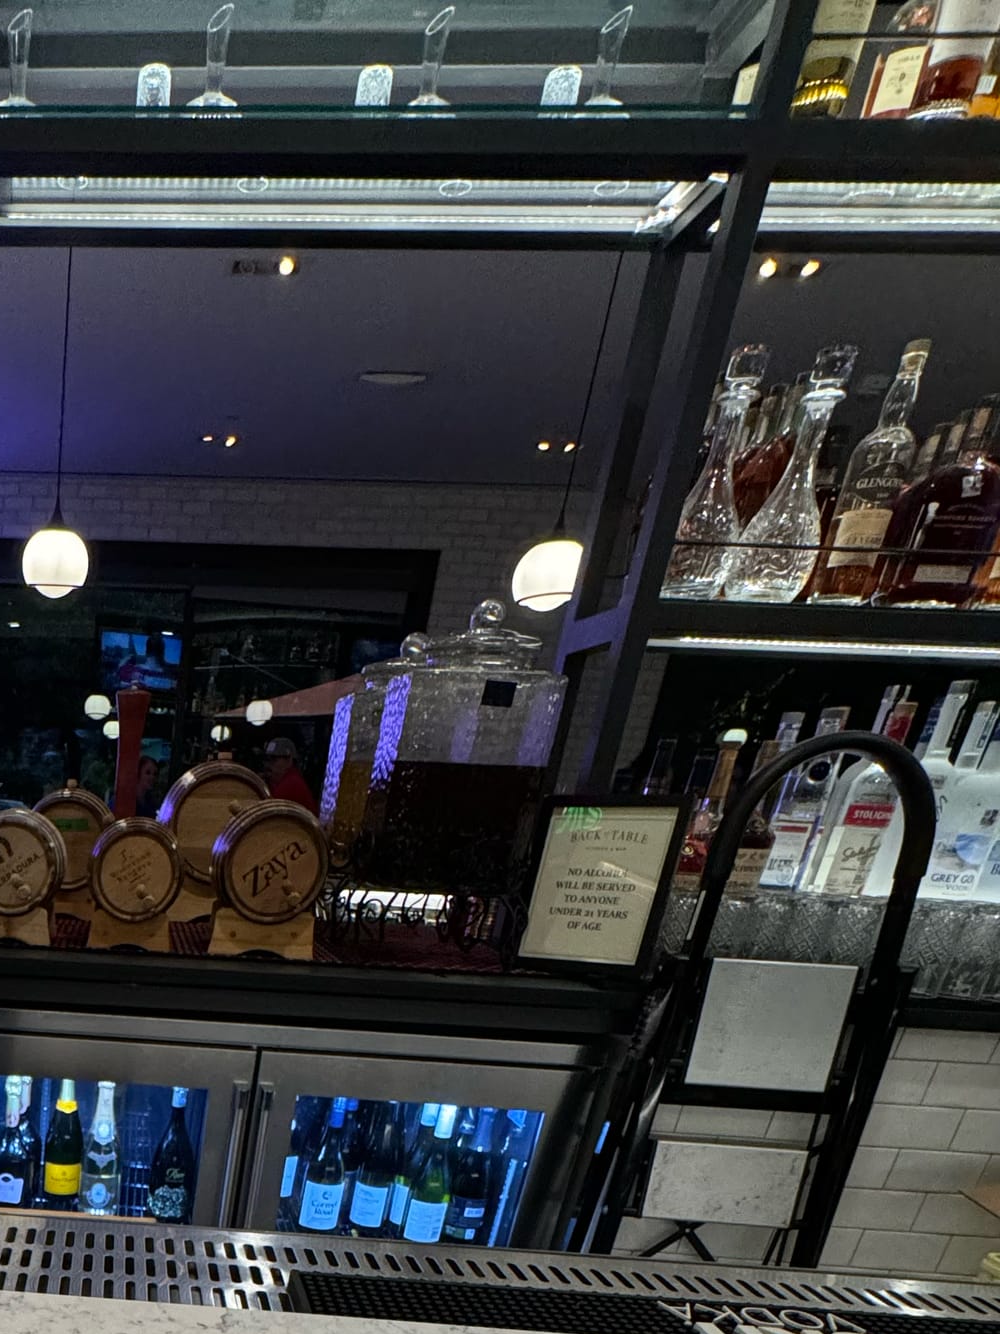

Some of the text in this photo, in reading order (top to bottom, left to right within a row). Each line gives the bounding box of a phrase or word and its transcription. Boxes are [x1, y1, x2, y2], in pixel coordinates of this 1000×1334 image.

[570, 830, 649, 845] BACK TABLE
[242, 840, 307, 899] Zaya
[568, 868, 582, 876] NO
[931, 873, 960, 883] GREY
[556, 880, 636, 893] WILL BE SERVED
[564, 895, 620, 905] TO ANYONE
[549, 907, 628, 920] UNDER 21 YEARS
[567, 920, 602, 931] OF AGE
[657, 1299, 867, 1334] VODKA
